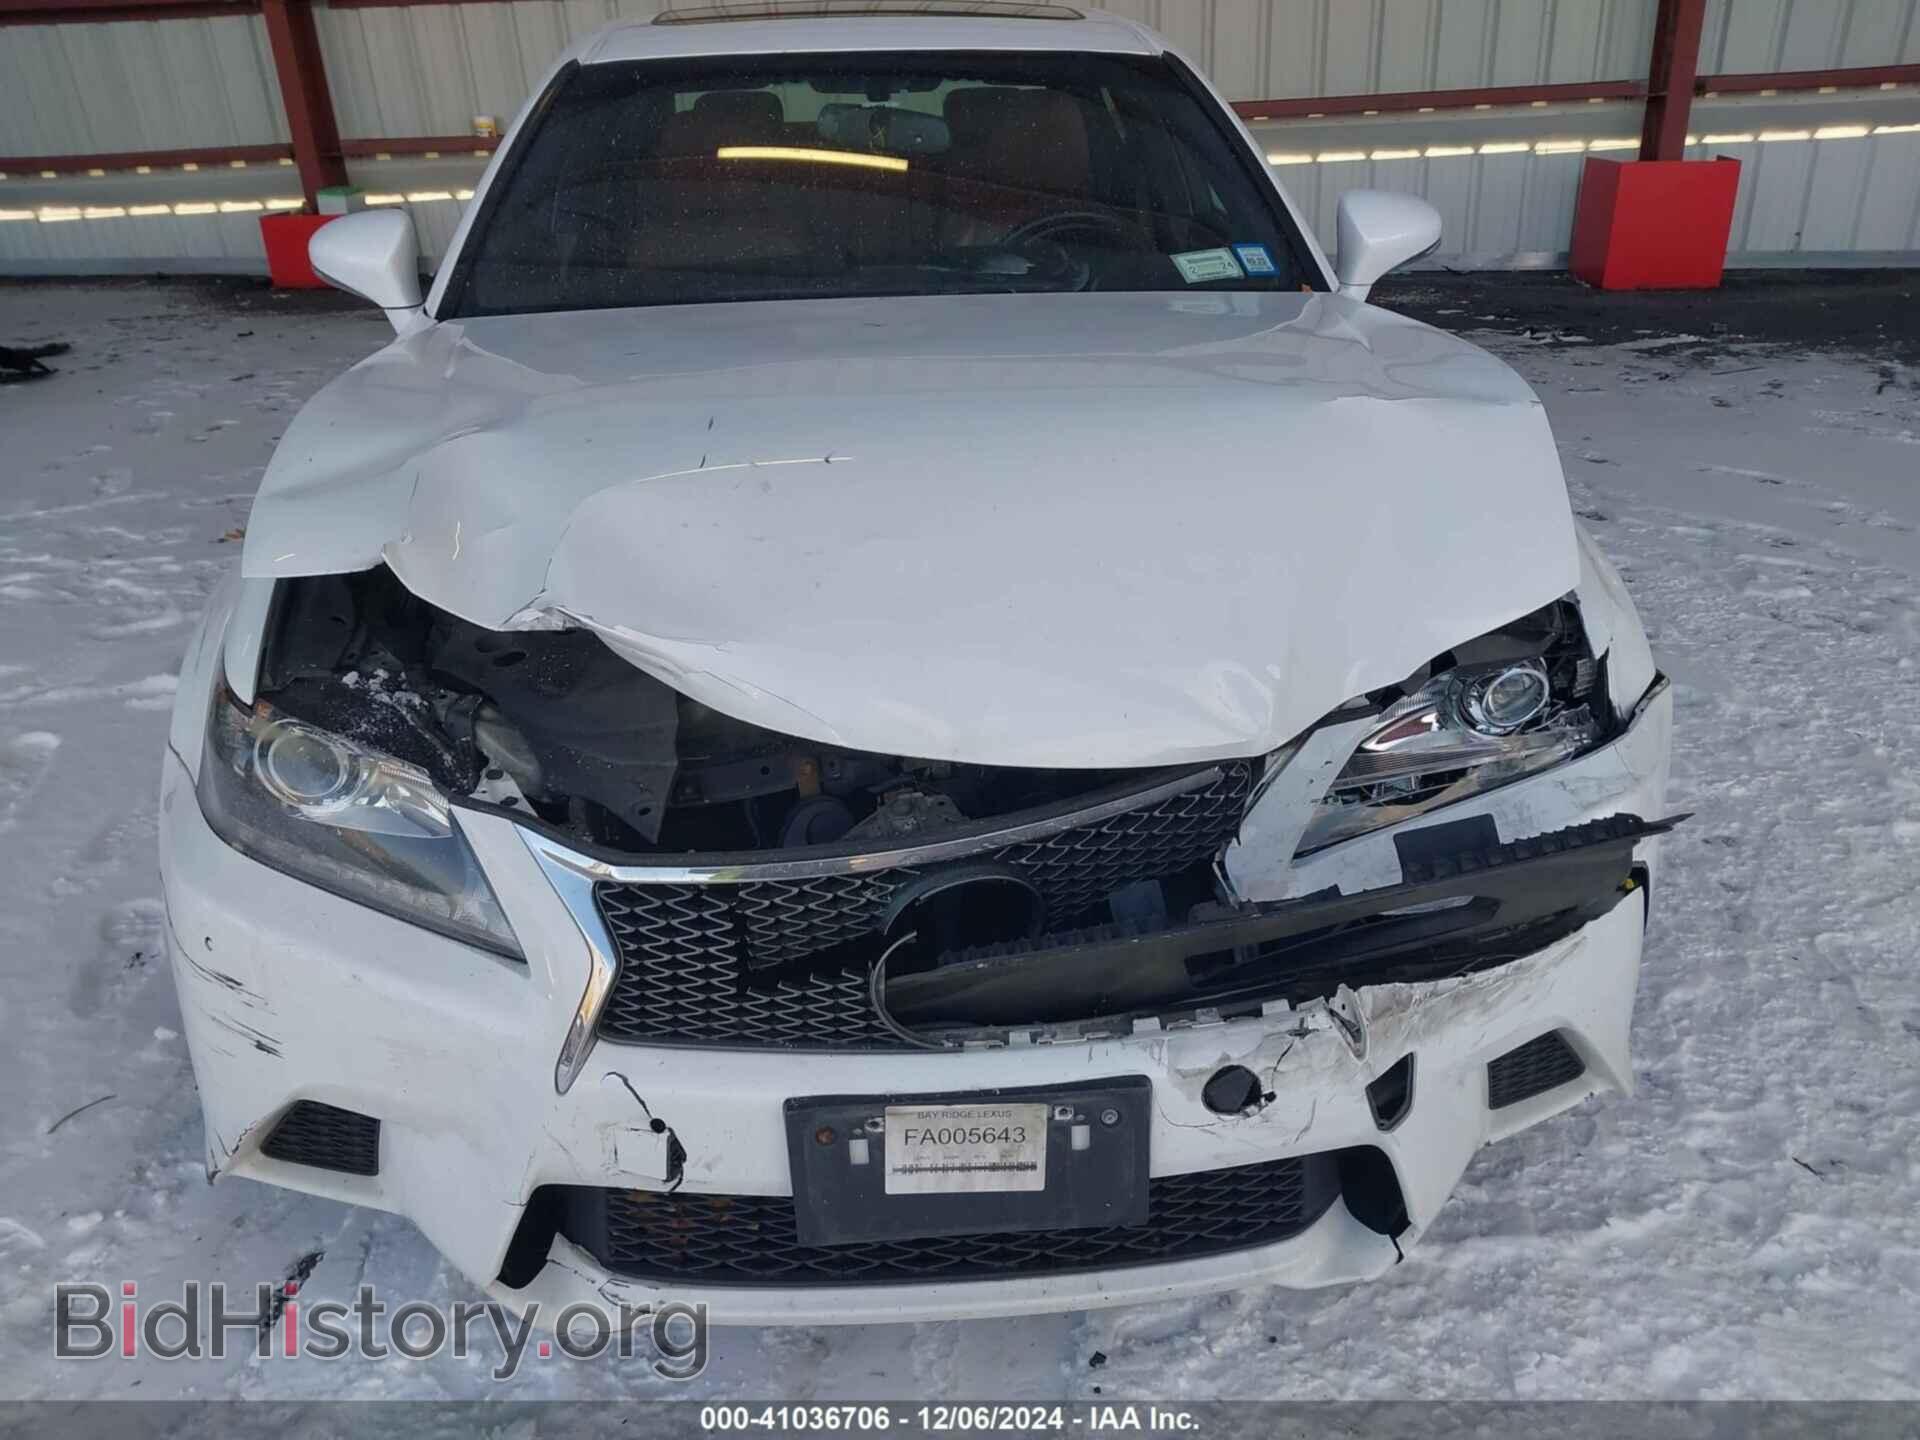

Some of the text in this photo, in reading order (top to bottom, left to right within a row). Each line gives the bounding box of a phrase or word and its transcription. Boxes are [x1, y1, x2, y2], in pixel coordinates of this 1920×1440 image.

[917, 1110, 938, 1120] BAY
[941, 1109, 975, 1119] RIDGE
[903, 1126, 1027, 1146] FA005643
